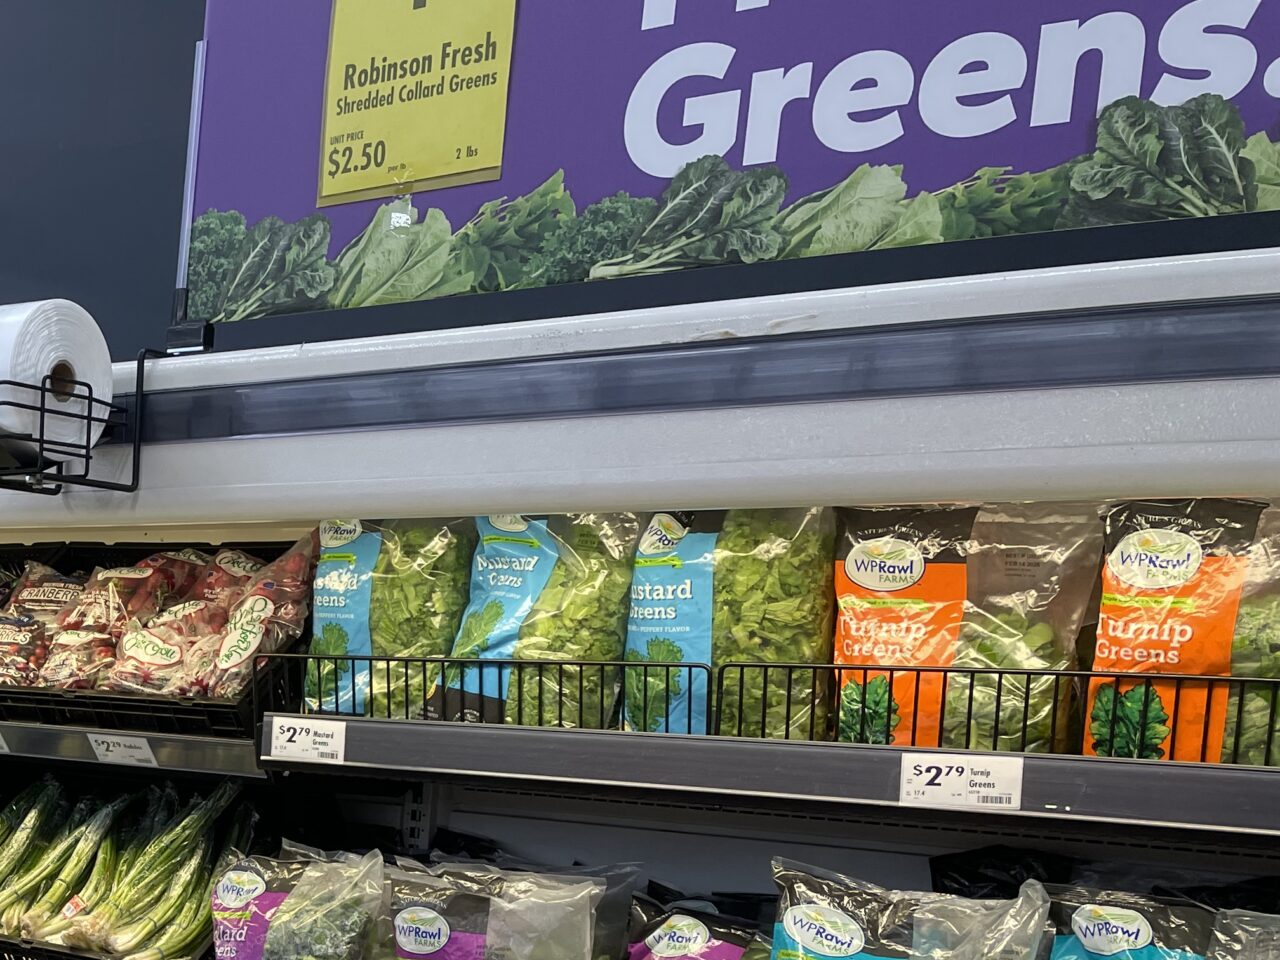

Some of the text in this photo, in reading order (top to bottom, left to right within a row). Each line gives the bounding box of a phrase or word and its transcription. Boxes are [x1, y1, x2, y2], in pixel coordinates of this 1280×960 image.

[343, 31, 498, 91] Robinson Fresh
[336, 72, 498, 116] Shredded Collard Greens
[330, 130, 365, 145] UNIT PRICE
[327, 140, 387, 179] $2.50
[455, 146, 478, 159] 2 lbs
[854, 559, 914, 575] WPRawl
[879, 575, 916, 584] FARMS
[18, 588, 81, 601] CRANBERR
[631, 579, 694, 601] ustard
[1096, 613, 1194, 648] Turnip
[1096, 640, 1181, 664] Greens
[313, 730, 334, 739] Mustard
[312, 739, 329, 747] Greens
[970, 768, 991, 779] Turnip
[969, 780, 996, 789] Greens
[398, 924, 442, 941] WPRawl
